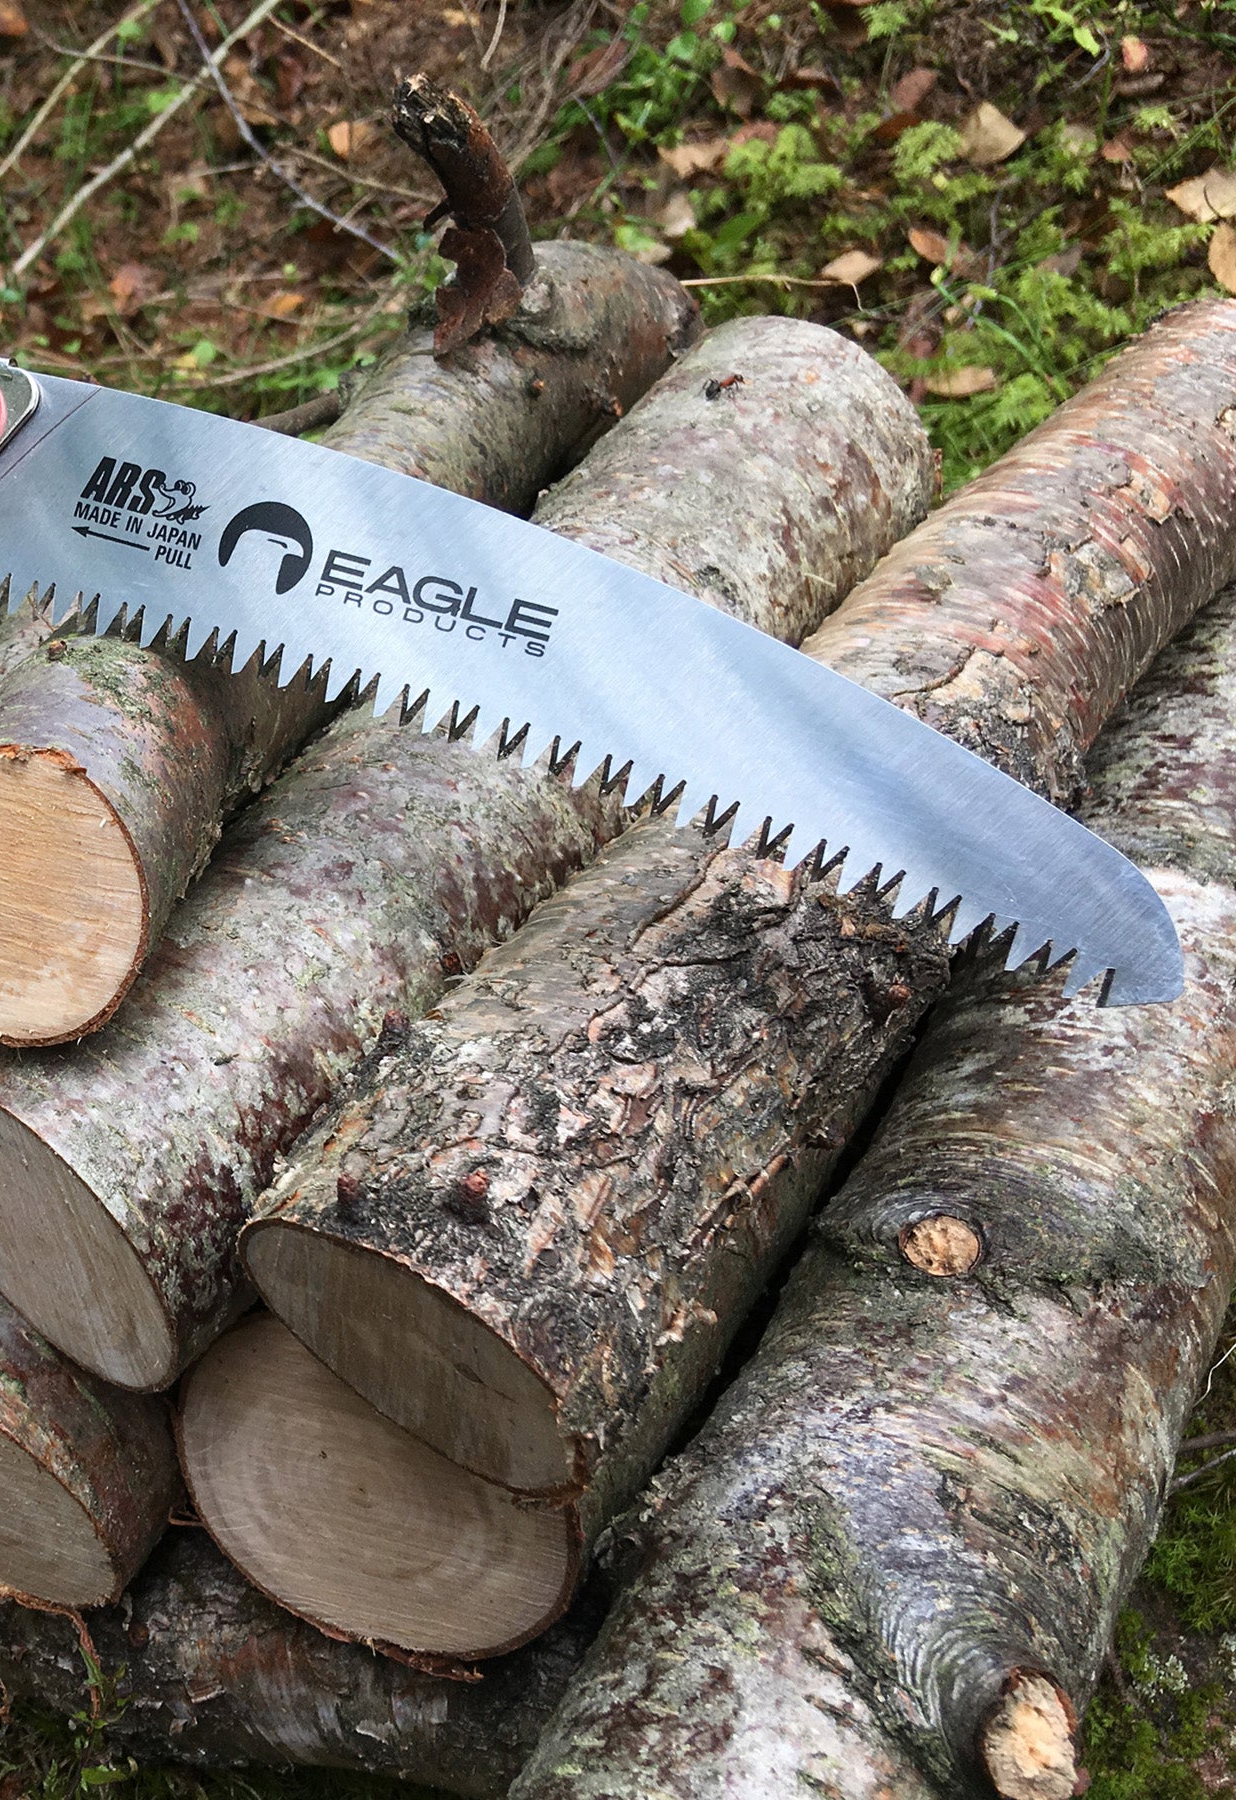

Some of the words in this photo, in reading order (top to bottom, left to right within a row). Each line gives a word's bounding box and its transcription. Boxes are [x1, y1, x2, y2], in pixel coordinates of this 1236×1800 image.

[80, 456, 167, 515] ARS
[73, 502, 122, 529] MADE
[125, 515, 144, 534] IN
[147, 523, 202, 551] JAPAN
[154, 545, 192, 570] PULL
[315, 584, 546, 657] PRODUCTS
[320, 549, 559, 642] EAGLE
